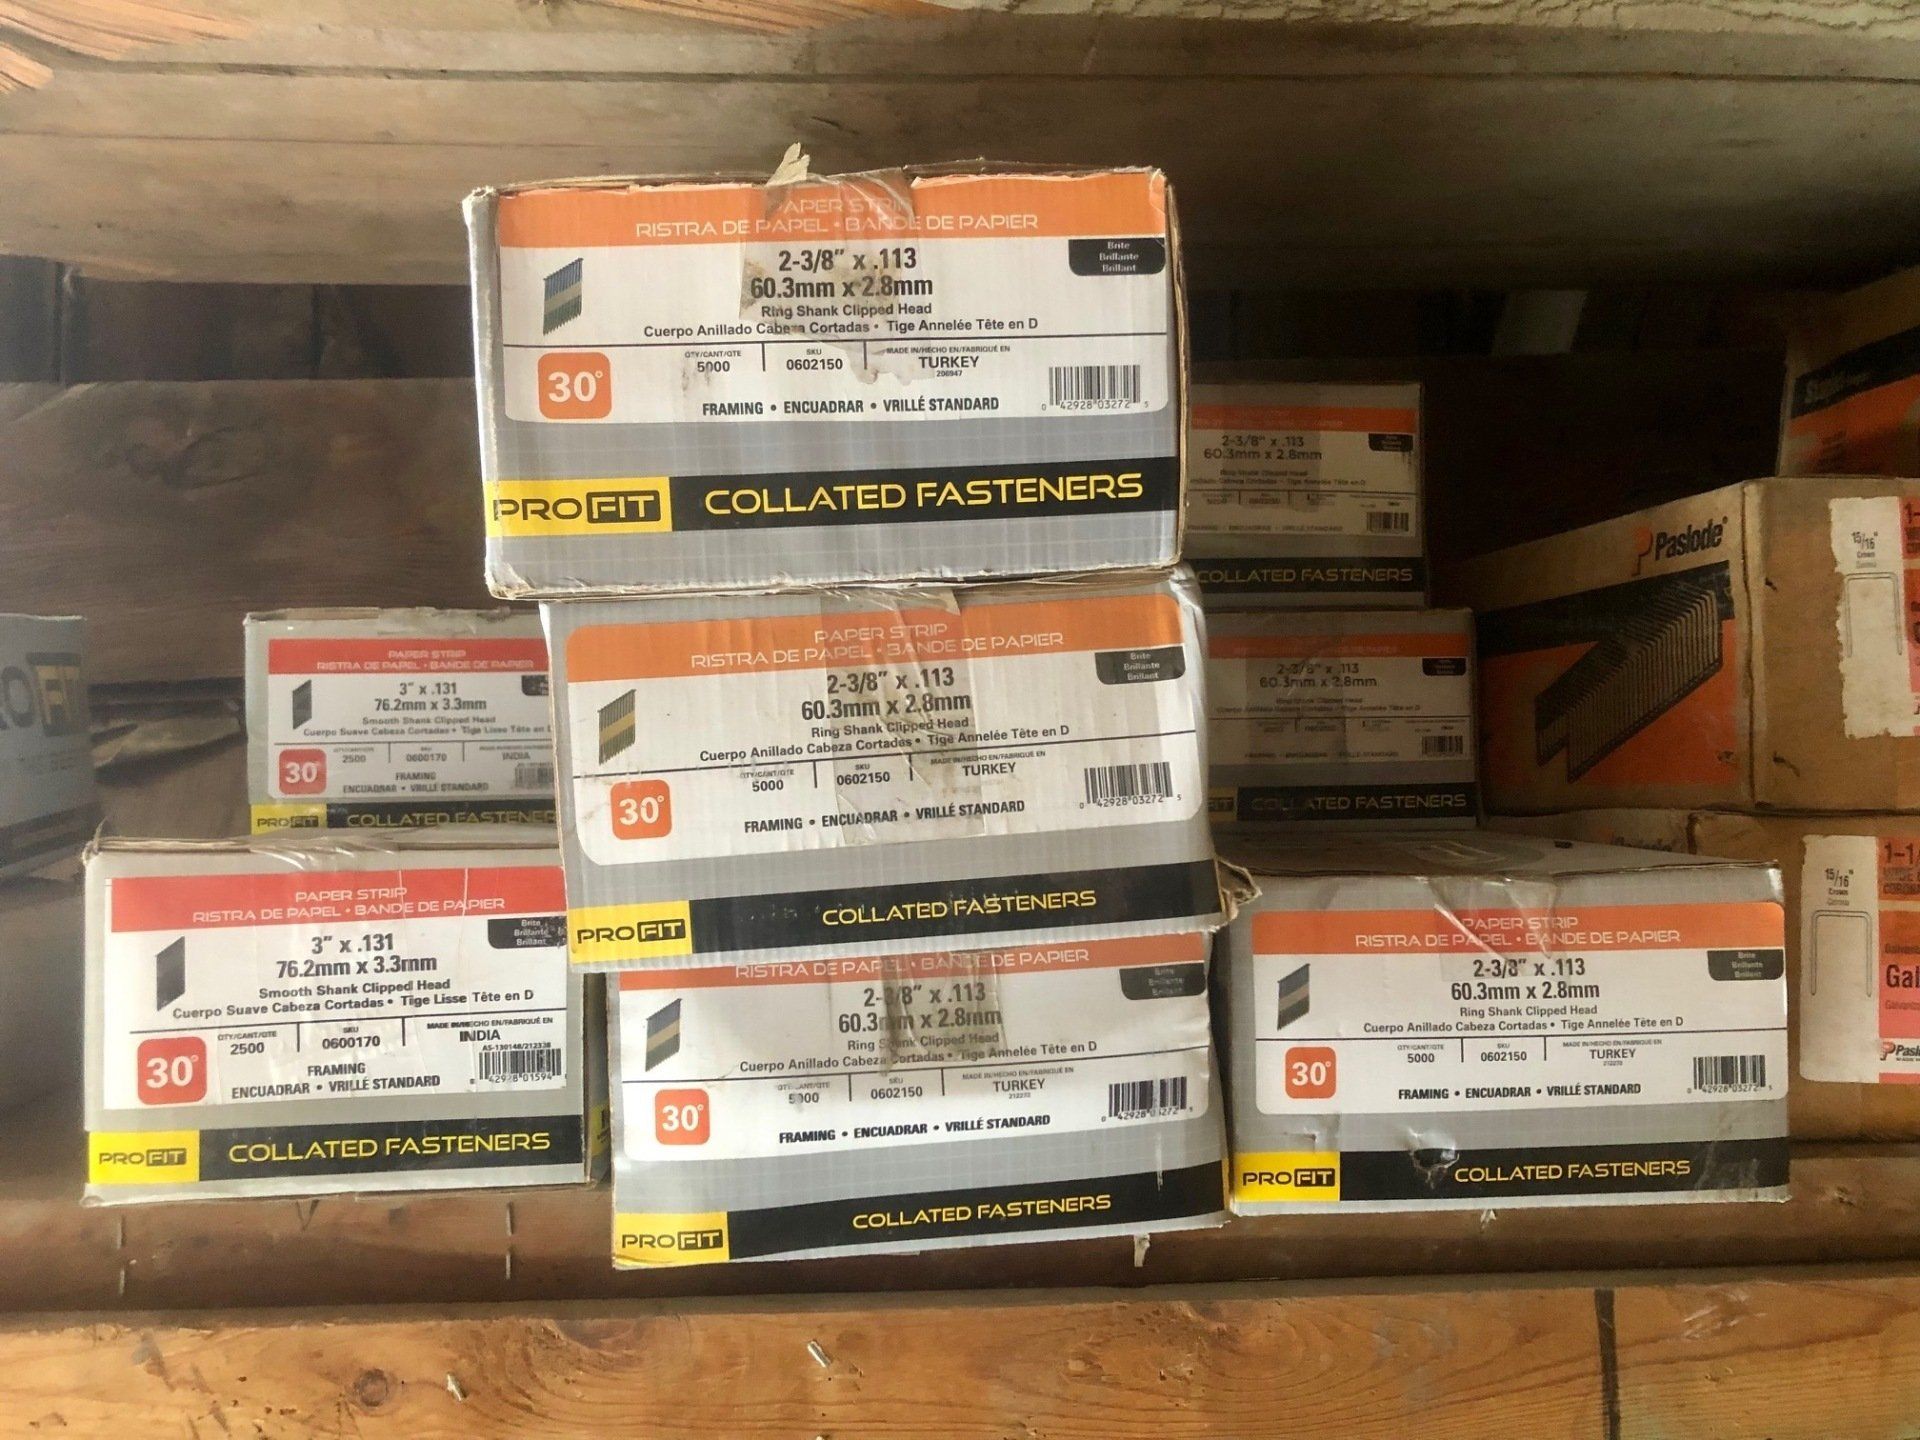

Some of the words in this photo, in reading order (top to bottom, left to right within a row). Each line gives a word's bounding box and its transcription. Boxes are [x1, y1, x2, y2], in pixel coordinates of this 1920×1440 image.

[852, 254, 866, 271] x
[873, 247, 917, 270] .113
[750, 278, 835, 300] 60.3mm
[842, 281, 856, 298] x
[861, 275, 934, 297] 2.8mm
[761, 304, 793, 319] Ring
[796, 303, 838, 318] Shank
[841, 302, 894, 318] Clipped
[898, 301, 932, 315] Head
[643, 325, 694, 340] Cuerpo
[697, 322, 752, 337] Anillado
[809, 319, 870, 334] Cortadas
[887, 319, 915, 333] Tige
[918, 317, 973, 332] Annelée
[976, 317, 1005, 331] Tête
[1008, 320, 1025, 330] en
[1028, 318, 1039, 330] D
[806, 348, 822, 356] SKU
[696, 360, 731, 374] 5000
[786, 357, 844, 371] 0602150
[918, 355, 980, 369] TURKEY
[702, 402, 764, 417] FRAMING
[783, 399, 865, 415] ENCUADRAR
[882, 394, 925, 413] VRILLÉ
[928, 396, 1000, 412] STANDARD
[1269, 437, 1277, 447] x
[1265, 451, 1272, 460] x
[704, 483, 907, 516] COLLATED
[916, 472, 1144, 508] FASTENERS
[1654, 521, 1724, 562] Paslode
[1197, 567, 1297, 584] COLLATED
[1300, 567, 1413, 582] FASTENERS
[814, 627, 884, 645] PAPER
[890, 623, 948, 640] STRIP
[1325, 665, 1333, 673] x
[895, 675, 908, 690] x
[914, 667, 955, 689] .113
[1320, 679, 1328, 688] x
[418, 686, 427, 695] x
[430, 682, 457, 696] .131
[374, 698, 427, 712] 76.2mm
[430, 701, 439, 711] x
[441, 698, 488, 712] 3.3mm
[801, 700, 881, 721] 60.3mm
[886, 700, 900, 715] x
[905, 693, 971, 714] 2.8mm
[502, 752, 531, 761] INDIA
[962, 762, 1017, 777] TURKEY
[751, 779, 785, 792] 5000
[836, 771, 891, 786] 0602150
[1355, 793, 1467, 810] FASTENERS
[346, 810, 456, 827] COLLATED
[743, 817, 803, 834] FRAMING
[821, 809, 898, 828] ENCUADRAR
[915, 800, 956, 820] VRILLÉ
[958, 799, 1026, 816] STANDARD
[295, 890, 353, 903] PAPER
[357, 887, 408, 899] STRIP
[193, 909, 257, 923] RISTRA
[260, 908, 283, 920] DE
[286, 906, 341, 919] PAPEL
[354, 902, 414, 915] BANDE
[417, 900, 440, 913] DE
[442, 898, 506, 911] PAPIER
[822, 902, 948, 926] COLLATED
[953, 889, 1097, 917] FASTENERS
[1461, 917, 1524, 930] PAPER
[1528, 916, 1579, 930] STRIP
[311, 935, 333, 955] 3"
[339, 940, 351, 952] x
[357, 933, 395, 952] .131
[1355, 934, 1421, 948] RISTRA
[1424, 934, 1449, 947] DE
[1452, 933, 1512, 947] PAPEL
[1525, 931, 1587, 946] BANDE
[1589, 930, 1614, 944] DE
[1616, 929, 1681, 943] PAPIER
[276, 959, 351, 978] 76.2mm
[355, 962, 368, 975] x
[373, 955, 438, 973] 3.3mm
[1534, 963, 1545, 976] x
[1550, 957, 1586, 976] .113
[1450, 981, 1521, 1001] 60.3mm
[1526, 985, 1538, 999] x
[1541, 980, 1600, 999] 2.8mm
[321, 1036, 381, 1050] 0600170
[459, 1029, 502, 1043] INDIA
[229, 1042, 265, 1056] 2500
[1480, 1051, 1528, 1063] 0602150
[1589, 1048, 1637, 1060] TURKEY
[1407, 1053, 1435, 1064] 5000
[306, 1062, 366, 1077] FRAMING
[231, 1081, 311, 1100] ENCUADRAR
[328, 1076, 370, 1094] VRILLÉ
[372, 1074, 441, 1090] STANDARD
[870, 1085, 924, 1100] 0602150
[992, 1078, 1046, 1093] TURKEY
[1398, 1088, 1449, 1101] FRAMING
[1465, 1086, 1532, 1099] ENCUADRAR
[1546, 1082, 1583, 1097] VRILLÉ
[1583, 1083, 1642, 1096] STANDARD
[778, 1128, 836, 1145] FRAMING
[853, 1123, 928, 1139] ENCUADRAR
[945, 1116, 985, 1133] VRILLÉ
[986, 1114, 1051, 1129] STANDARD
[228, 1138, 378, 1164] COLLATED
[385, 1131, 551, 1156] FASTENERS
[1454, 1165, 1563, 1183] COLLATED
[1567, 1160, 1691, 1179] FASTENERS
[852, 1206, 972, 1230] COLLATED
[977, 1194, 1112, 1219] FASTENERS
